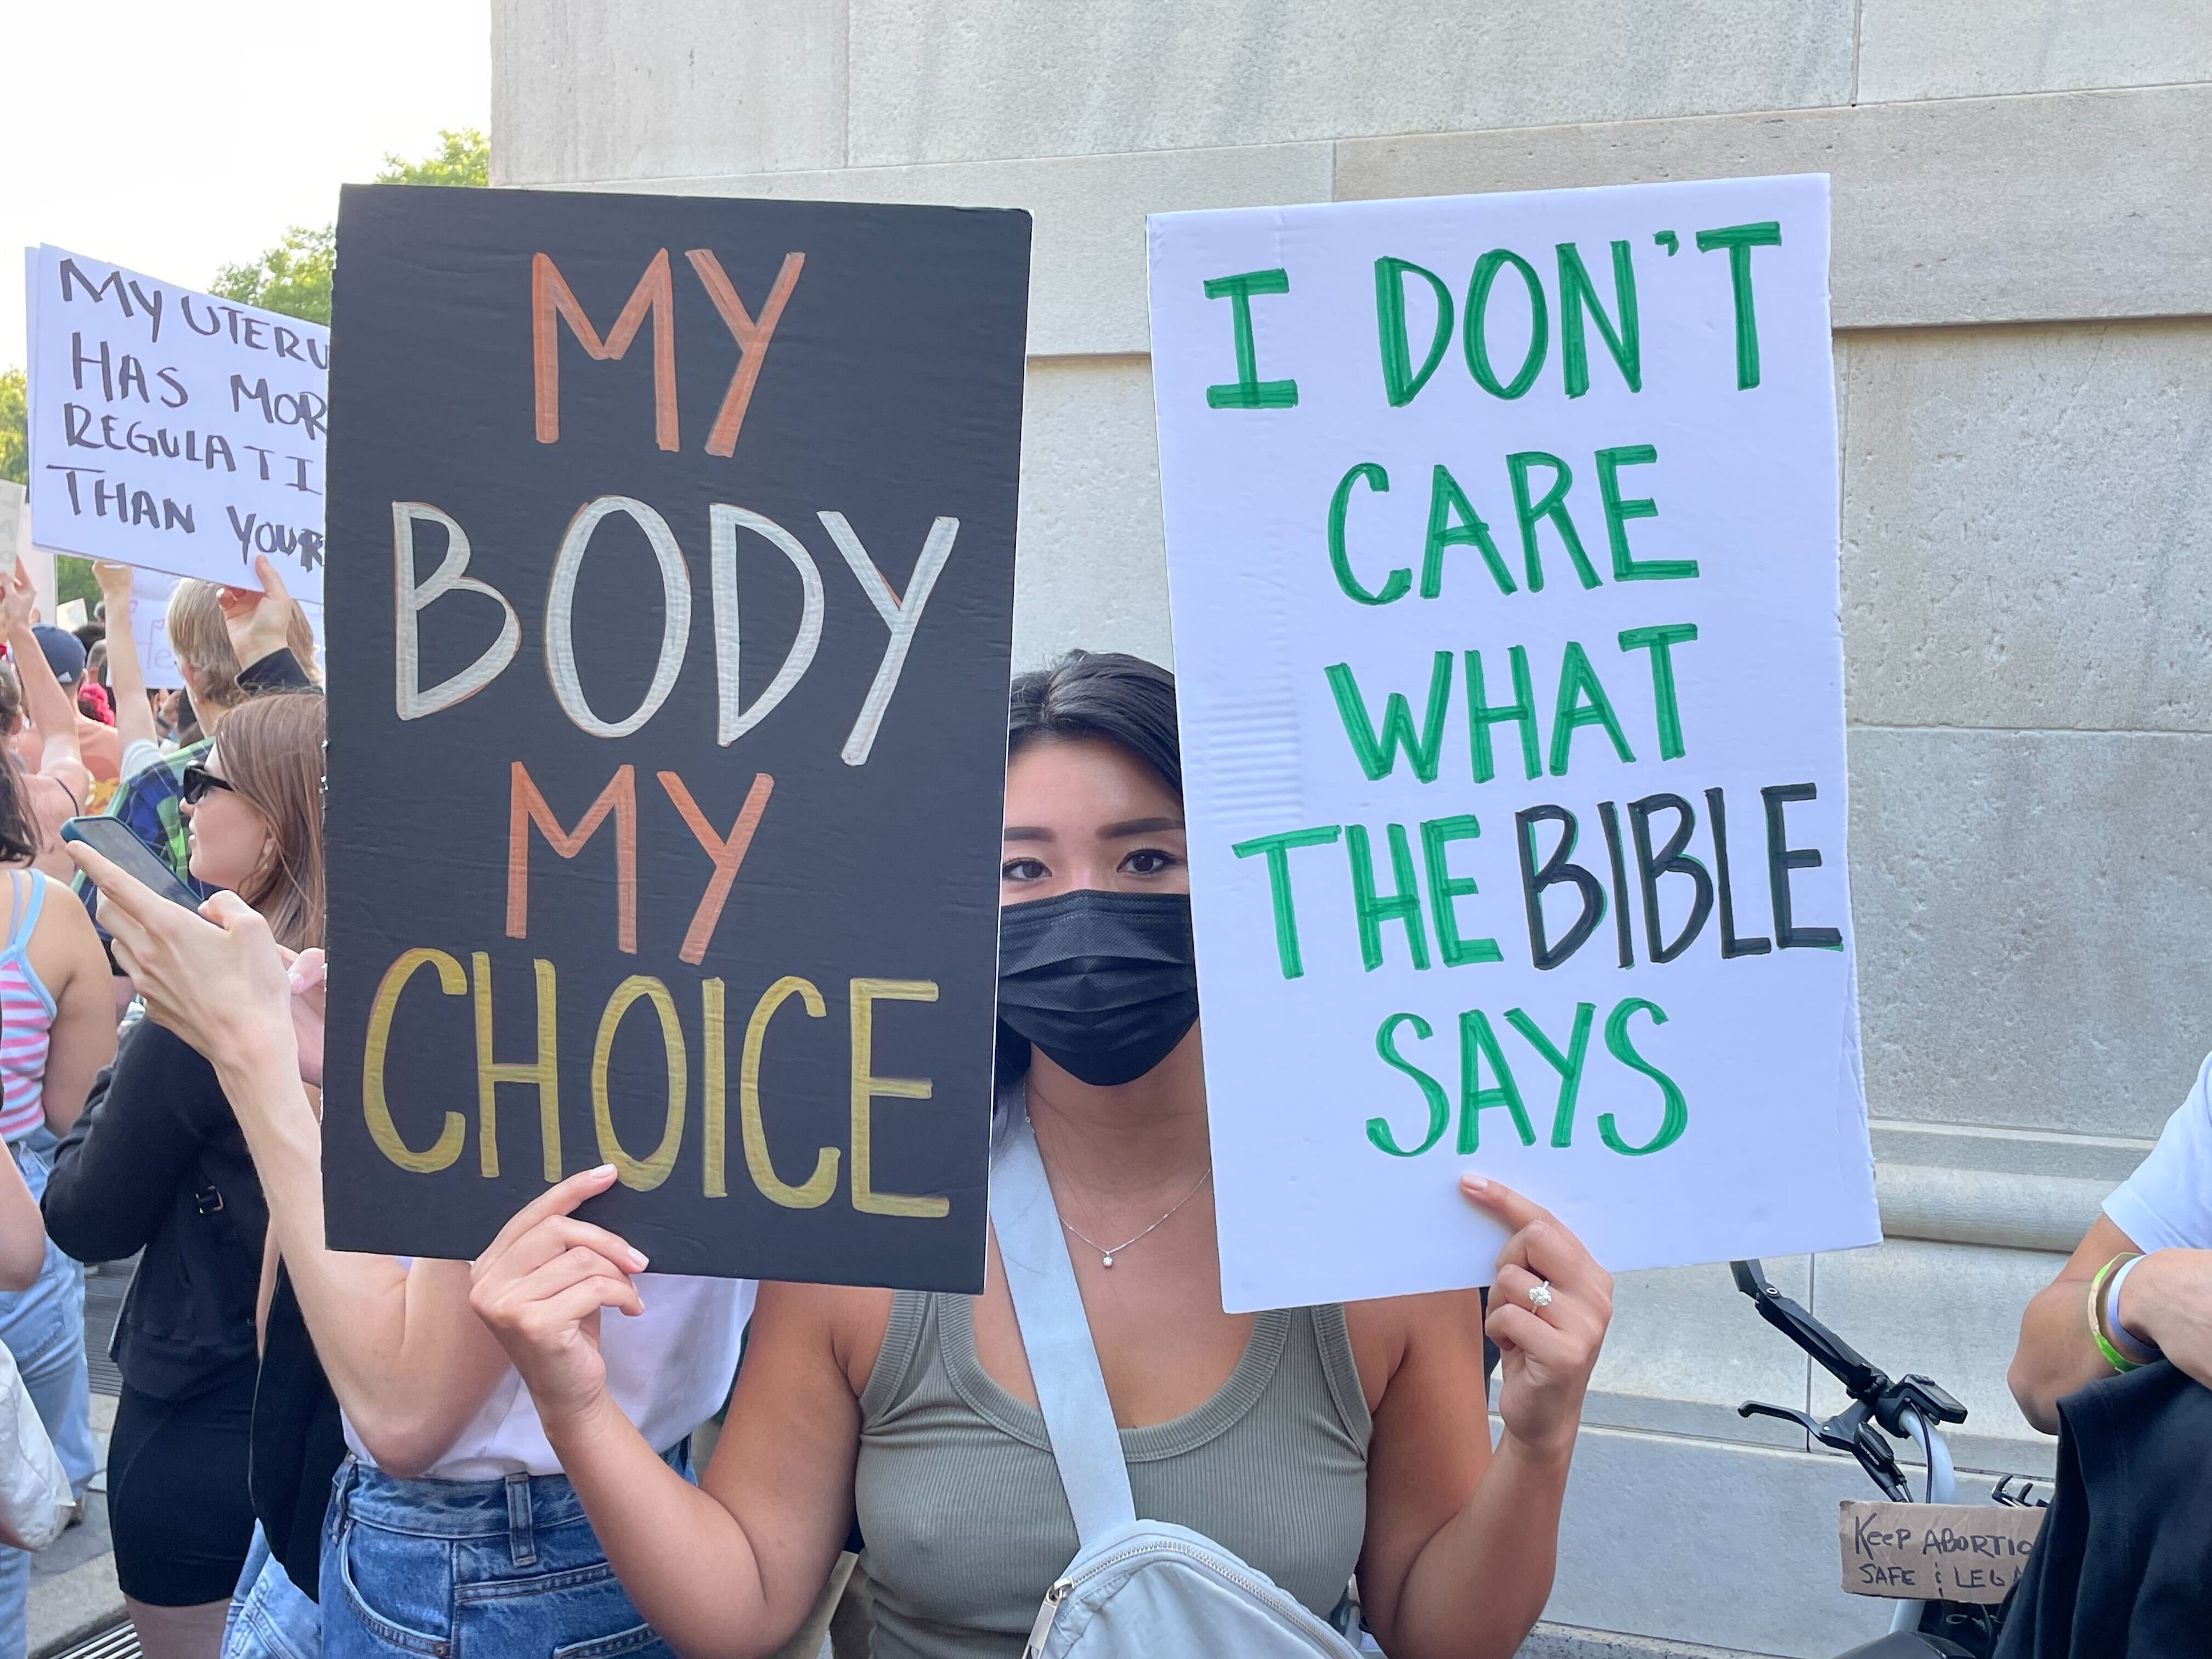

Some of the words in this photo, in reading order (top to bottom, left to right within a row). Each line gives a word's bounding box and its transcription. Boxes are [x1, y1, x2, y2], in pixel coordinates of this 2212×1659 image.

[60, 258, 162, 343] MY
[532, 248, 805, 458] MY
[1204, 268, 1299, 409] I
[1374, 221, 1782, 408] DON'T
[64, 402, 323, 495] REGULATI
[72, 332, 188, 408] HAS
[230, 374, 327, 440] MOR
[46, 464, 195, 534] THAN
[1328, 444, 1699, 606] CARE
[392, 495, 960, 766] BODY
[1324, 623, 1698, 784] WHAT
[505, 761, 775, 966] MY
[1232, 814, 1504, 980] THE
[1515, 782, 1844, 970] BIBLE
[363, 947, 950, 1218] CHOICE
[1365, 997, 1688, 1158] SAYS
[1859, 1563, 1916, 1587] SAFE
